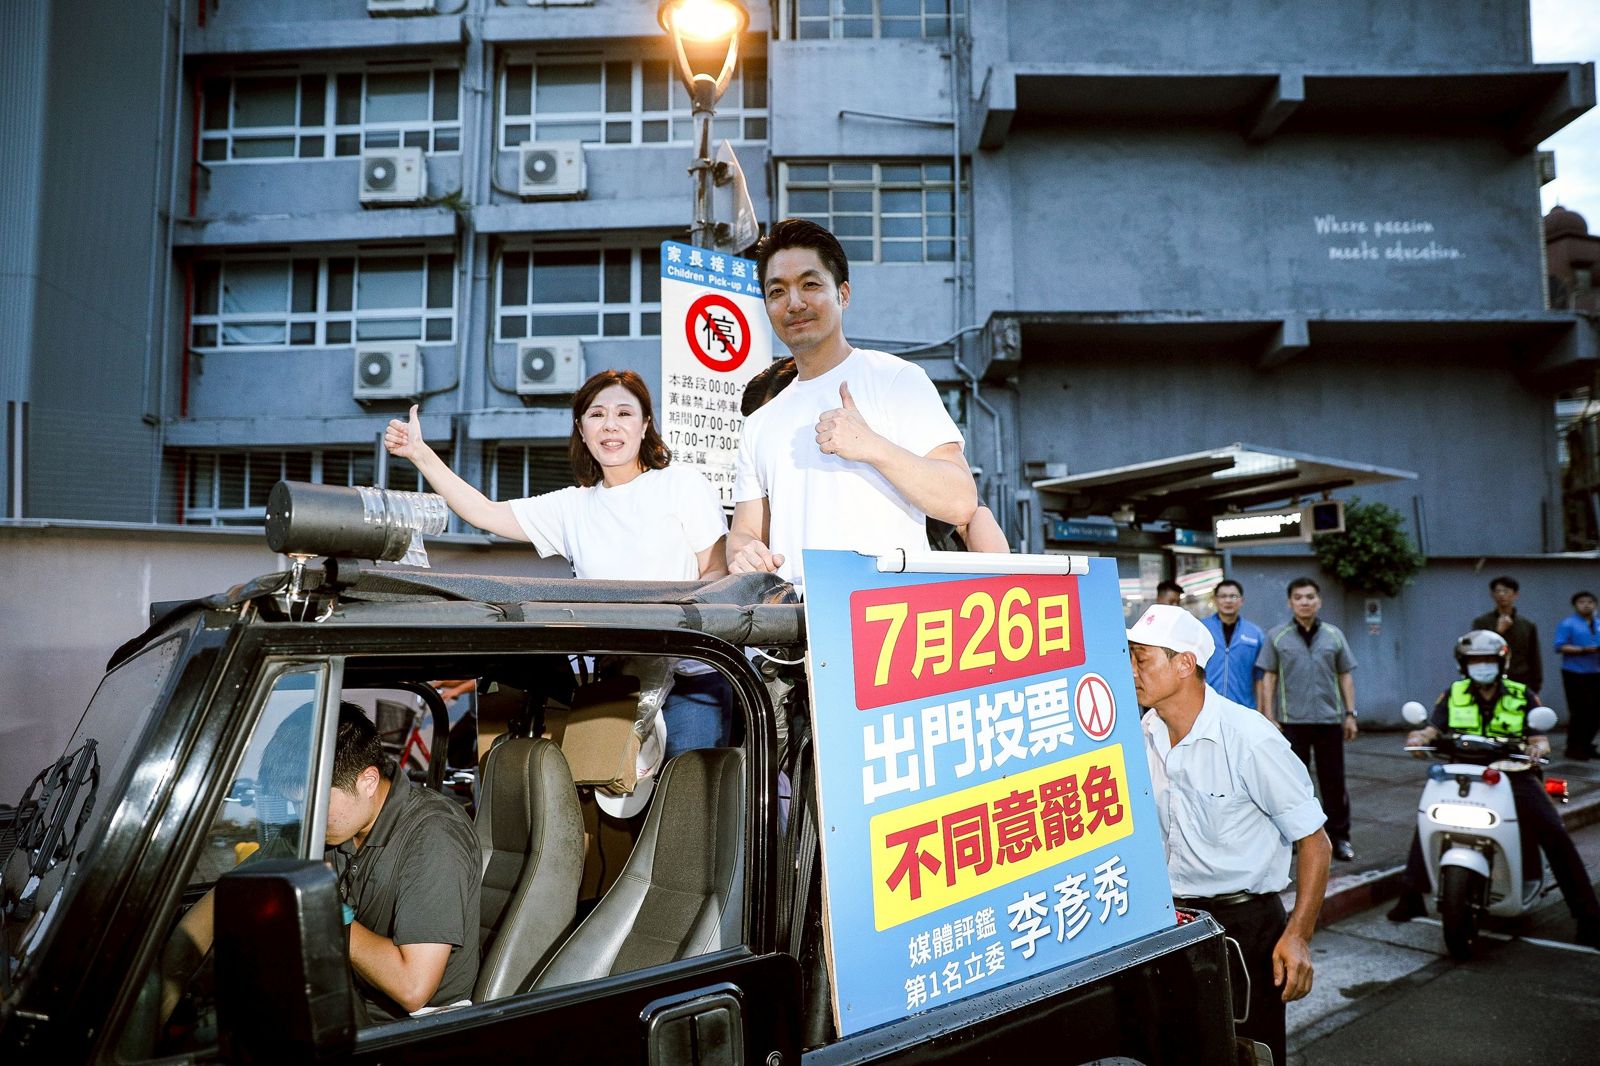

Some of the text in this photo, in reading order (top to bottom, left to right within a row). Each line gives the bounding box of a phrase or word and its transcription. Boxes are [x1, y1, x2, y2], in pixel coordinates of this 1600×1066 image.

[1314, 214, 1368, 234] Where
[1329, 240, 1379, 260] meets
[667, 266, 761, 294] Children Pick-up Are
[703, 313, 735, 353] 停
[864, 585, 1071, 687] 7月26日
[863, 678, 1076, 805] 出門投票
[885, 765, 1124, 901] 不同意罷免
[908, 906, 997, 968] 媒體評鑑
[1007, 855, 1129, 960] 李彥秀
[904, 941, 1006, 1010] 第1名立委
